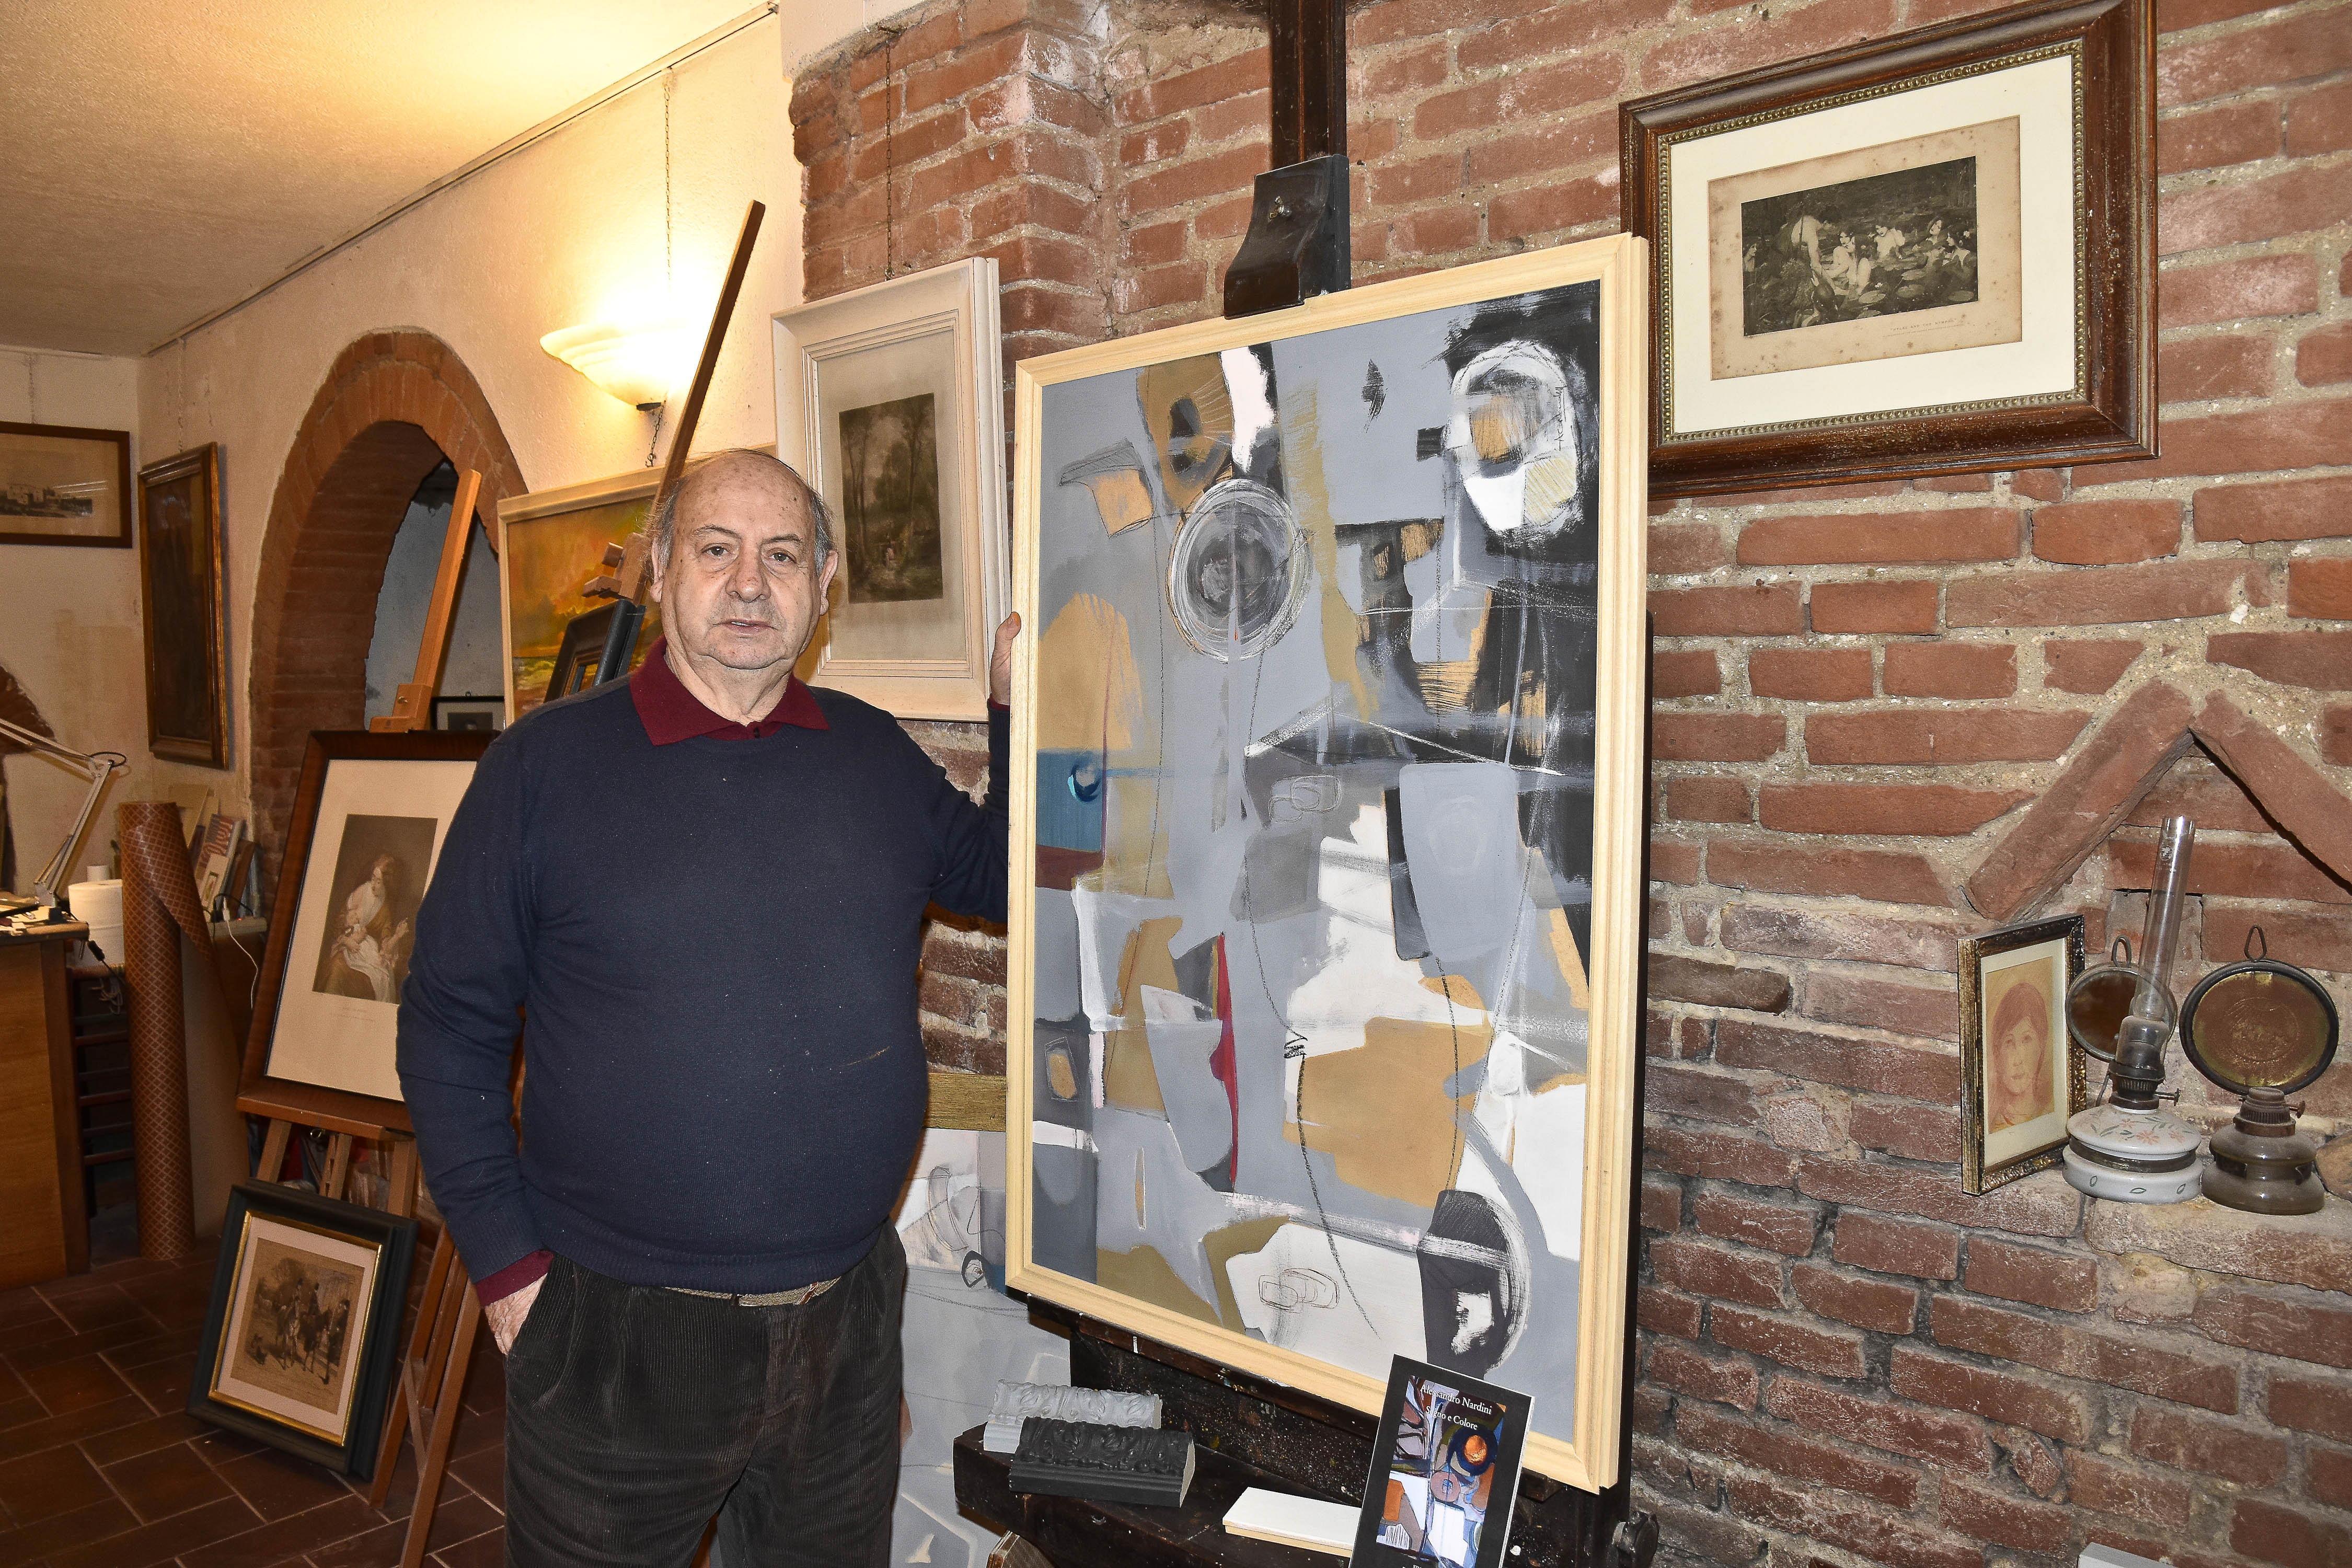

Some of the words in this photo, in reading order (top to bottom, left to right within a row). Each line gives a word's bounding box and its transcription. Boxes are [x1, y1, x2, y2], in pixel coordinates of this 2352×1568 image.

[1420, 1385, 1460, 1404] Alessandro
[1461, 1397, 1492, 1414] Nardini
[1425, 1405, 1446, 1419] Segno
[1453, 1415, 1478, 1430] Colore
